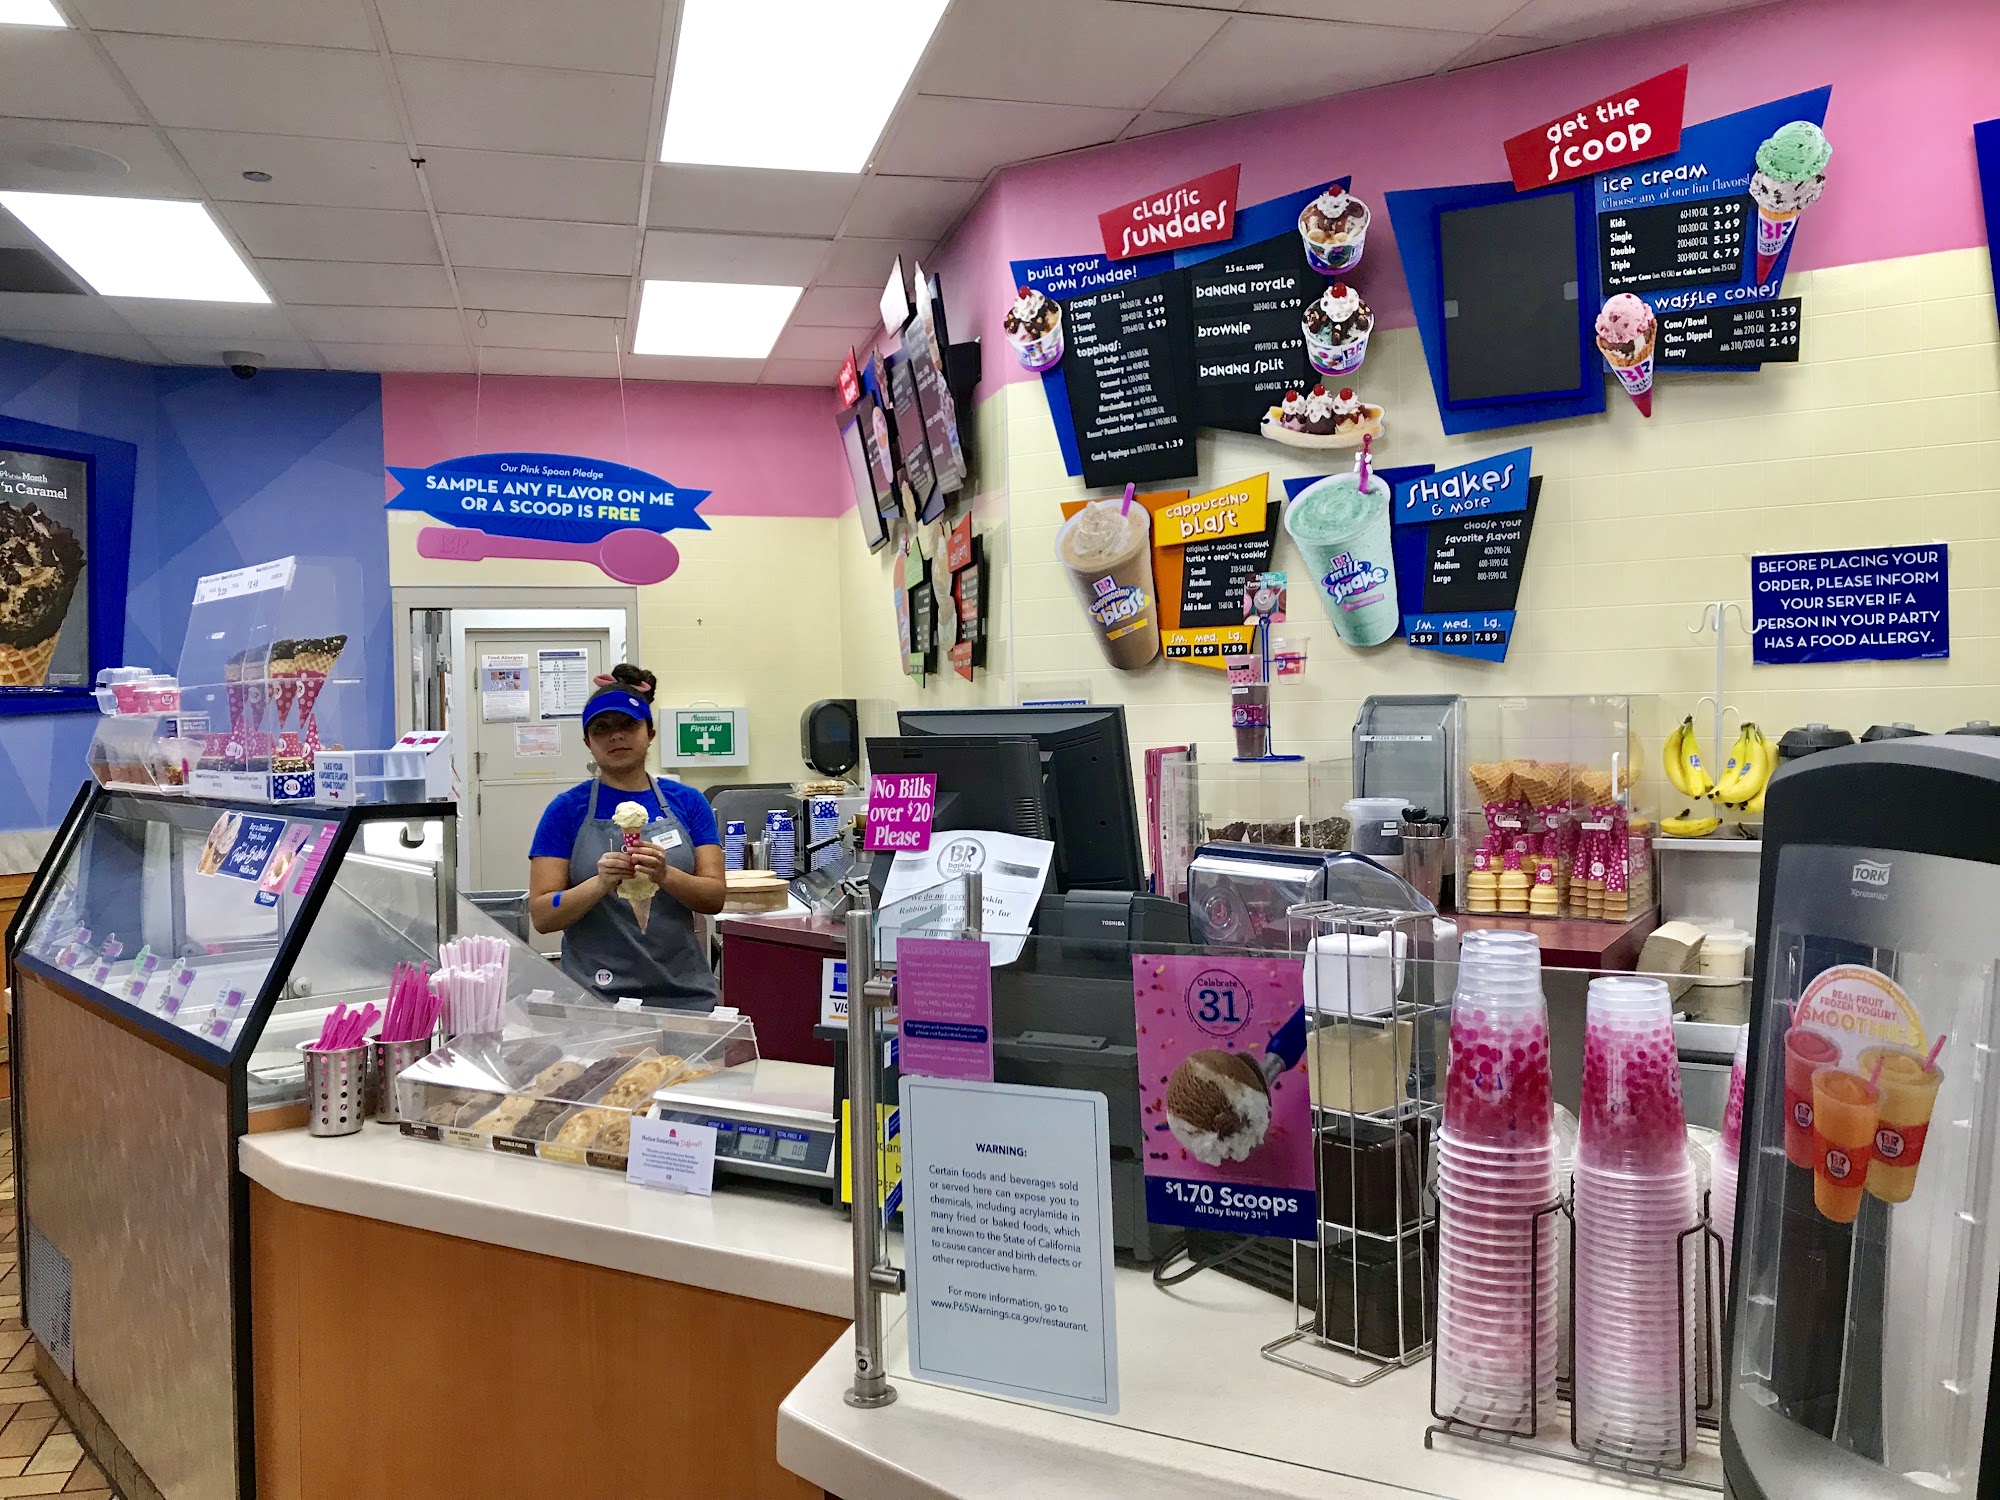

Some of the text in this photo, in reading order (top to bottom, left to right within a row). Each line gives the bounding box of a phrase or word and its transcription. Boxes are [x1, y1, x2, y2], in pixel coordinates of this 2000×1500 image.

[1547, 113, 1588, 145] get
[1603, 163, 1709, 194] ice cream
[1610, 203, 1740, 229] Kids 2.99
[1610, 219, 1740, 242] Single 3.69
[1610, 233, 1740, 256] Double 5.59
[1611, 248, 1740, 271] Triple 6.79
[1028, 264, 1063, 282] build
[1196, 283, 1246, 298] banana
[1145, 294, 1163, 306] 4.49
[1281, 299, 1301, 308] 6.99
[1654, 291, 1718, 310] waffle
[1146, 307, 1165, 317] 5.99
[1664, 307, 1796, 330] Cone/Bowl 1.59
[1148, 319, 1166, 330] 6.99
[1665, 321, 1797, 343] Choc. Dipped 2.29
[1282, 340, 1302, 349] 6.99
[1665, 335, 1797, 359] Fancy 2.49
[1200, 363, 1249, 377] banana
[1284, 380, 1304, 388] 7.99
[22, 472, 48, 482] Month
[500, 463, 604, 480] Our Pink Spoon Pledge
[16, 483, 67, 499] Caramel
[426, 475, 674, 506] SAMPLE ANY FLAVOR ON ME
[461, 497, 640, 522] OR A SCOOP IS FREE
[1432, 503, 1444, 515] &
[1437, 549, 1455, 558] Small
[1759, 551, 1938, 573] BEFORE PLACING YOUR
[1330, 560, 1363, 581] milk
[1434, 561, 1460, 570] Medium
[1433, 574, 1451, 584] Large
[1759, 572, 1938, 592] ORDER, PLEASE INFORM
[1781, 593, 1916, 610] YOUR SERVER IF A
[1760, 611, 1940, 629] PERSON IN YOUR PARTY
[1410, 633, 1498, 643] 5.89 6.89 7.89
[1765, 631, 1935, 649] HAS A FOOD ALLERGY.
[1167, 645, 1243, 655] 5.89 6.89 7.89
[874, 777, 931, 799] No Bills
[870, 803, 931, 822] over $20
[874, 826, 920, 846] Please
[950, 846, 977, 862] BR
[1854, 868, 1887, 883] TORK
[598, 972, 610, 982] BR
[1197, 978, 1237, 988] Celebrate
[1199, 989, 1240, 1023] 31
[1832, 989, 1883, 1007] REAL FRUIT
[1820, 997, 1897, 1021] FROZEN YOGURT
[976, 1143, 1027, 1157] WARNING:
[929, 1165, 1078, 1191] Certain foods and beverages sold
[1166, 1181, 1298, 1216] $1.70 Scoops
[930, 1195, 1079, 1223] chemicals, including acrylamide in
[1195, 1205, 1249, 1220] All Day Every
[933, 1254, 1037, 1277] other reproductive harm.
[931, 1299, 1088, 1332] www.P65Warnings.ca.gov/restaurant.
